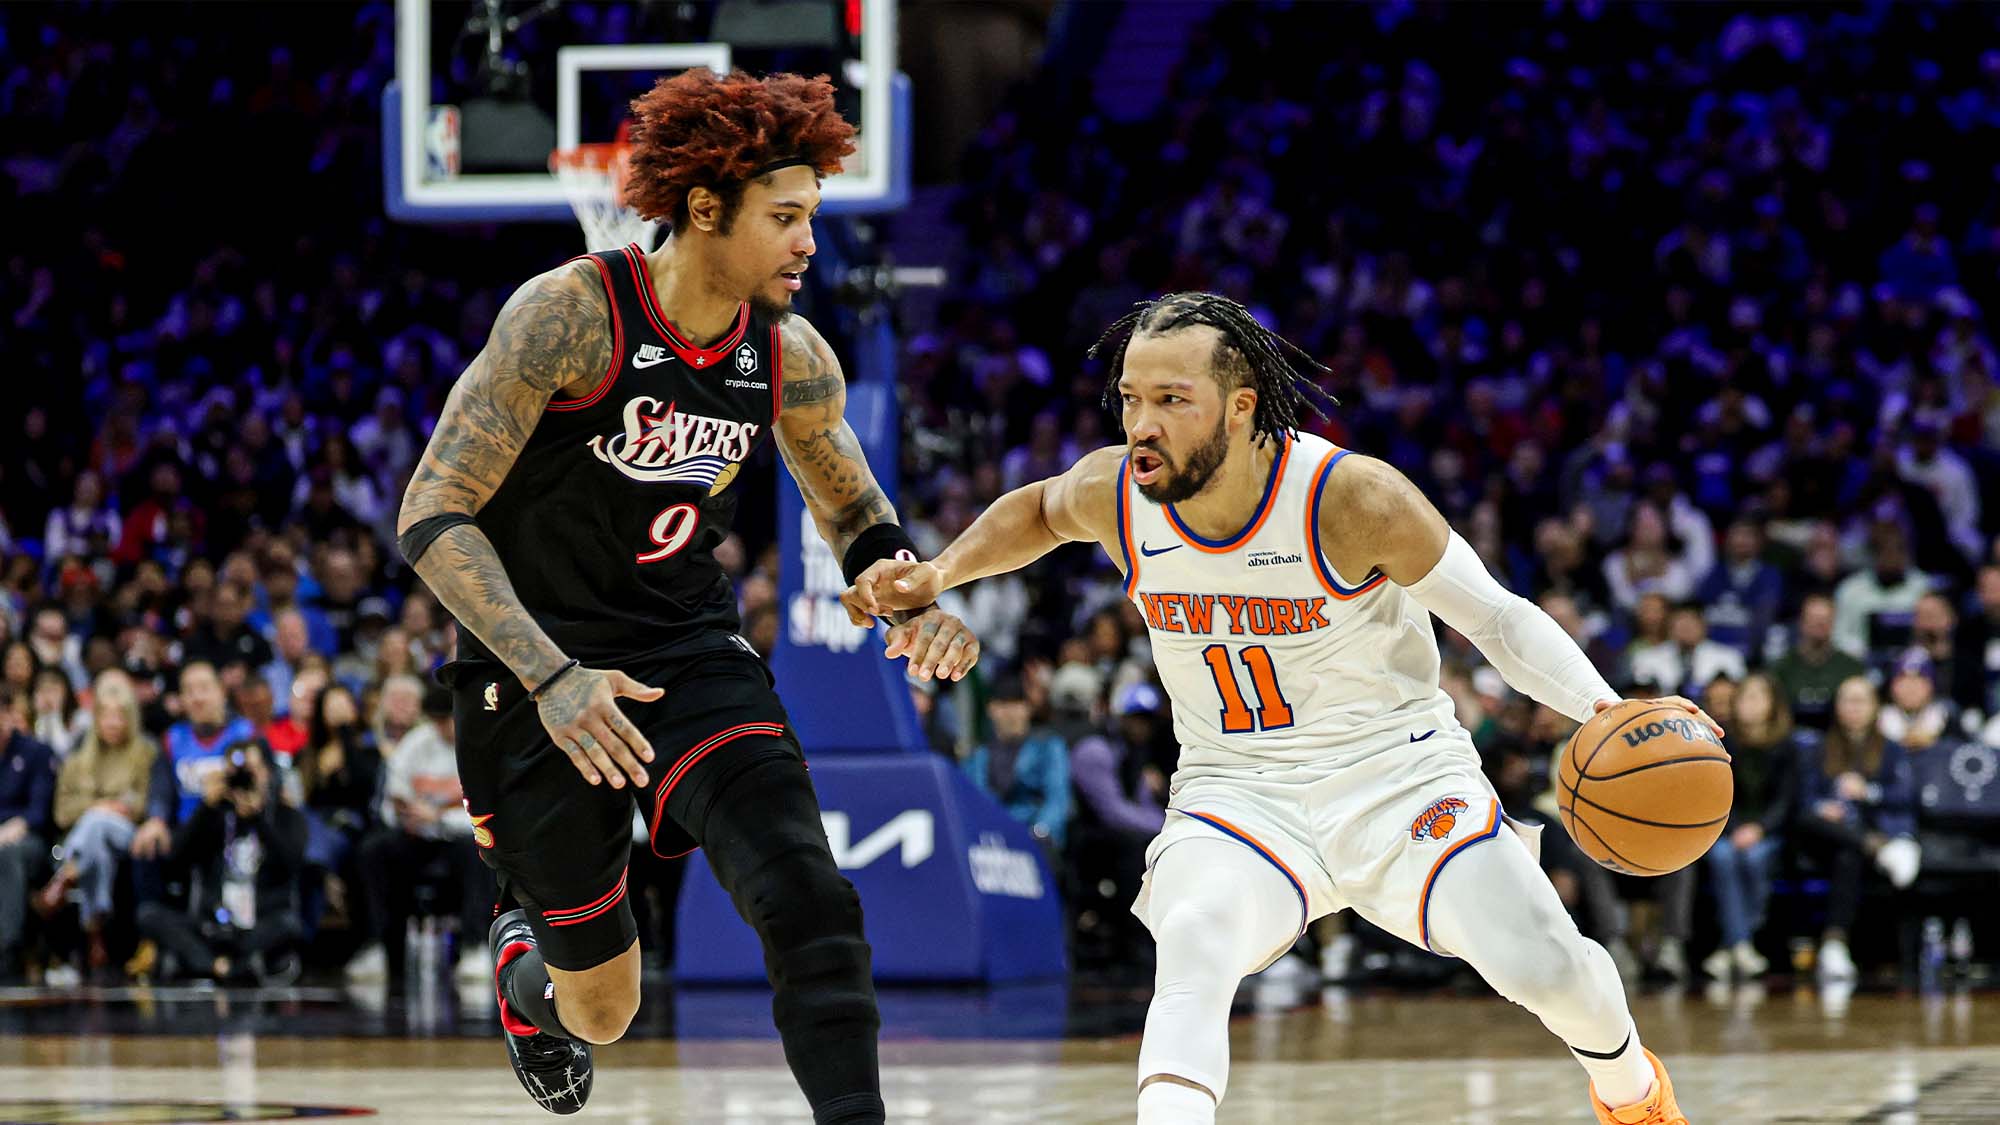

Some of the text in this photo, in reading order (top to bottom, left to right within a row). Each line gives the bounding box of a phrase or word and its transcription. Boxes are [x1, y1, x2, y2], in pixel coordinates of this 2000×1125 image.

[638, 344, 666, 361] NIKE
[725, 378, 768, 390] crypto.com
[636, 503, 699, 564] 9
[1248, 553, 1302, 567] abu dhabi
[1140, 592, 1330, 635] NEW YORK
[1202, 644, 1294, 734] 11
[1411, 797, 1469, 841] KNICKS
